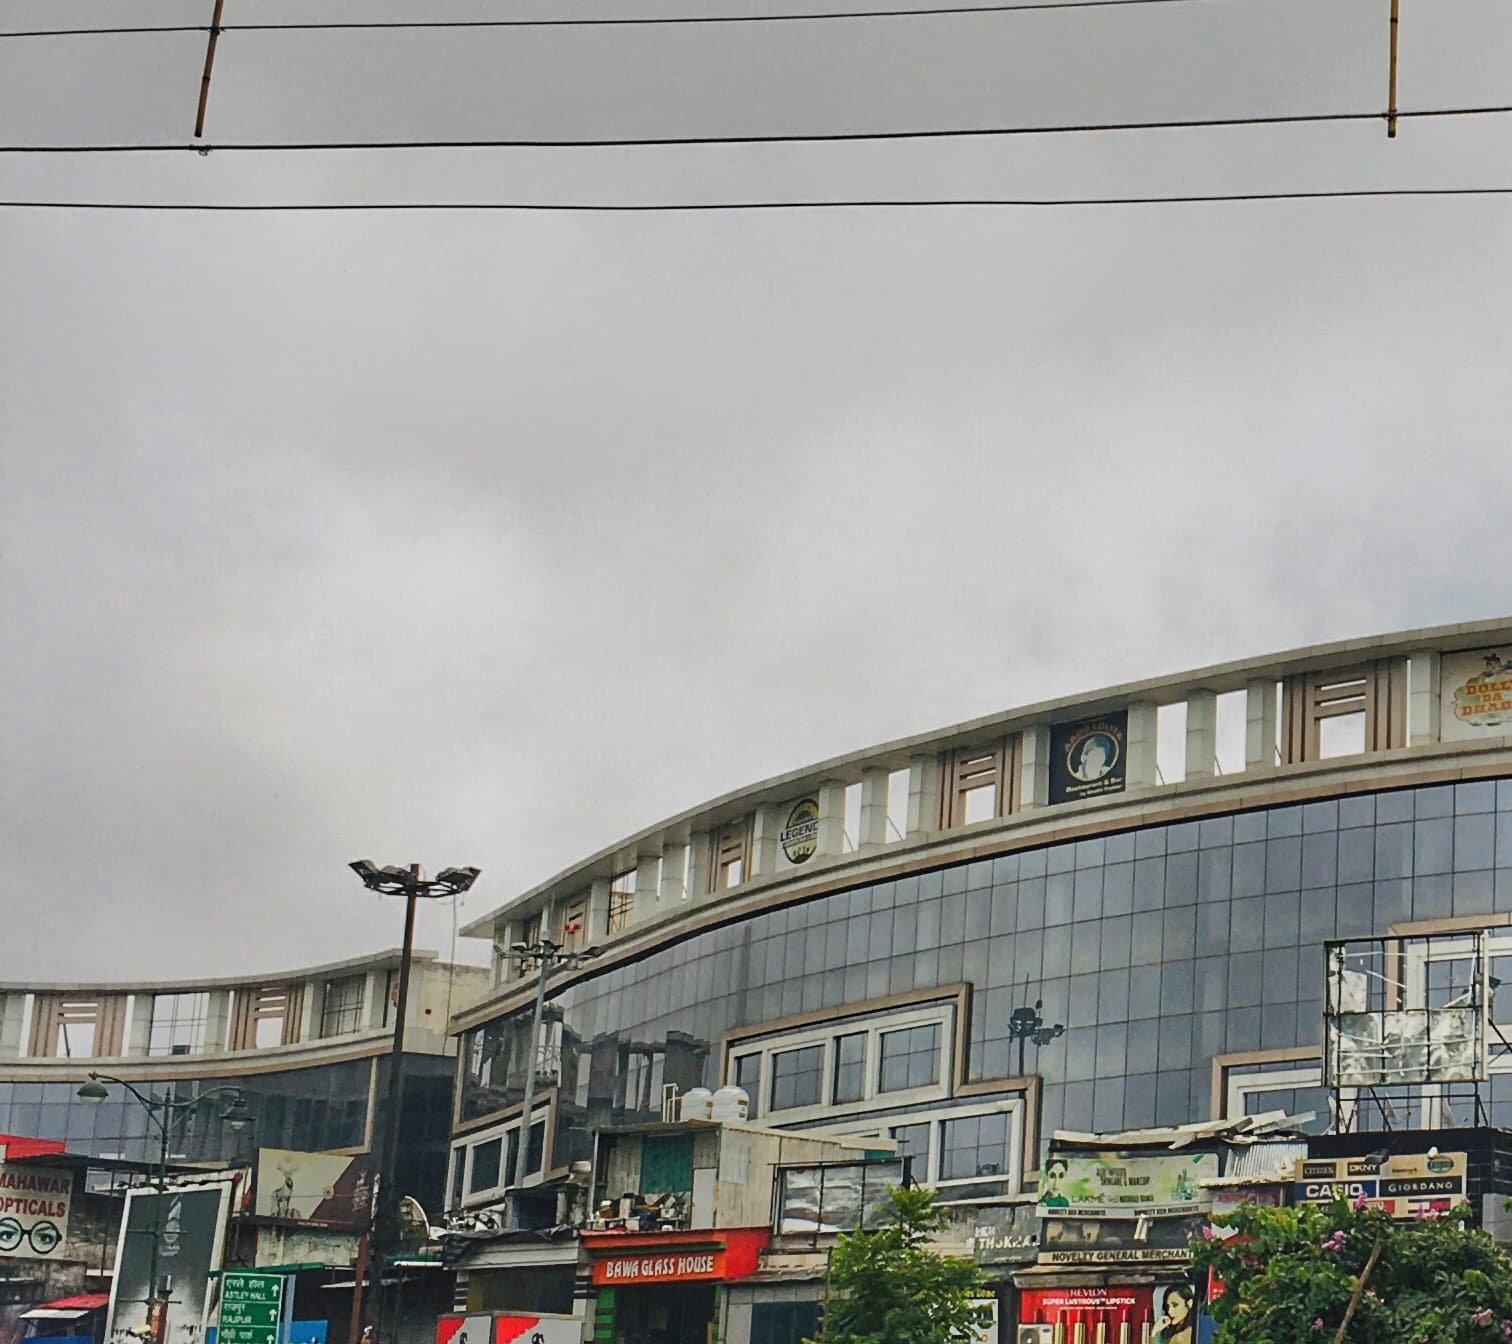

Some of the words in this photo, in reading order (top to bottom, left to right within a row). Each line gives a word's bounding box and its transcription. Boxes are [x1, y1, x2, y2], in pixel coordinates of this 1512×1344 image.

[1349, 1164, 1377, 1172] DKNY
[1388, 1181, 1453, 1193] GIORDANO
[1052, 1251, 1095, 1262] NOVELTY
[1096, 1251, 1140, 1261] GENERAL
[605, 1259, 639, 1278] BAWA
[641, 1257, 675, 1277] GLASS
[678, 1255, 714, 1275] HOUSE
[1070, 1288, 1108, 1297] REVLON
[1042, 1297, 1065, 1306] SUPER
[1106, 1297, 1136, 1305] LIPSTICK
[222, 1315, 252, 1324] RAJPUR
